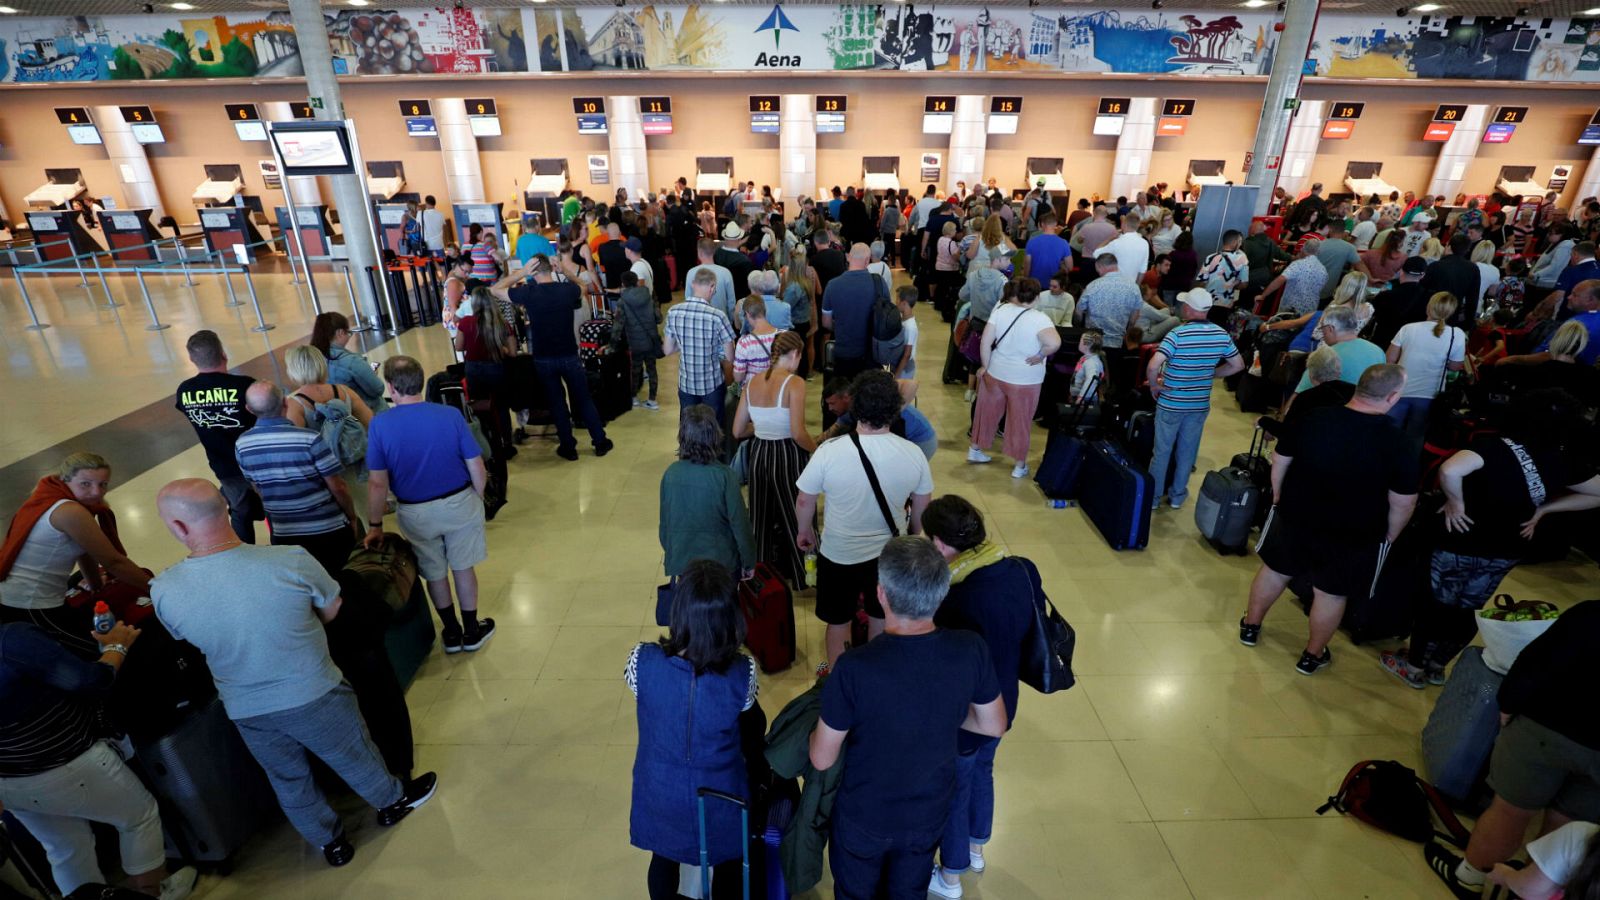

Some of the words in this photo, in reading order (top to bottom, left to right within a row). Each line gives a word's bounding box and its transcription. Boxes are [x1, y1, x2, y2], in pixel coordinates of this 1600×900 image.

[754, 52, 801, 67] Aena
[412, 105, 420, 115] 8
[477, 104, 485, 114] 9
[583, 103, 596, 113] 10
[650, 102, 662, 112] 11
[759, 101, 771, 111] 12
[825, 100, 838, 110] 13
[934, 101, 946, 111] 14
[1000, 102, 1013, 112] 15
[1108, 103, 1120, 113] 16
[1172, 104, 1186, 114] 17
[133, 111, 142, 121] 5
[239, 109, 247, 119] 6
[303, 107, 310, 116] 7
[1340, 107, 1354, 117] 19
[1442, 110, 1457, 120] 20
[1504, 112, 1517, 121] 21
[70, 112, 78, 122] 4
[182, 388, 239, 405] ALCAÑIZ
